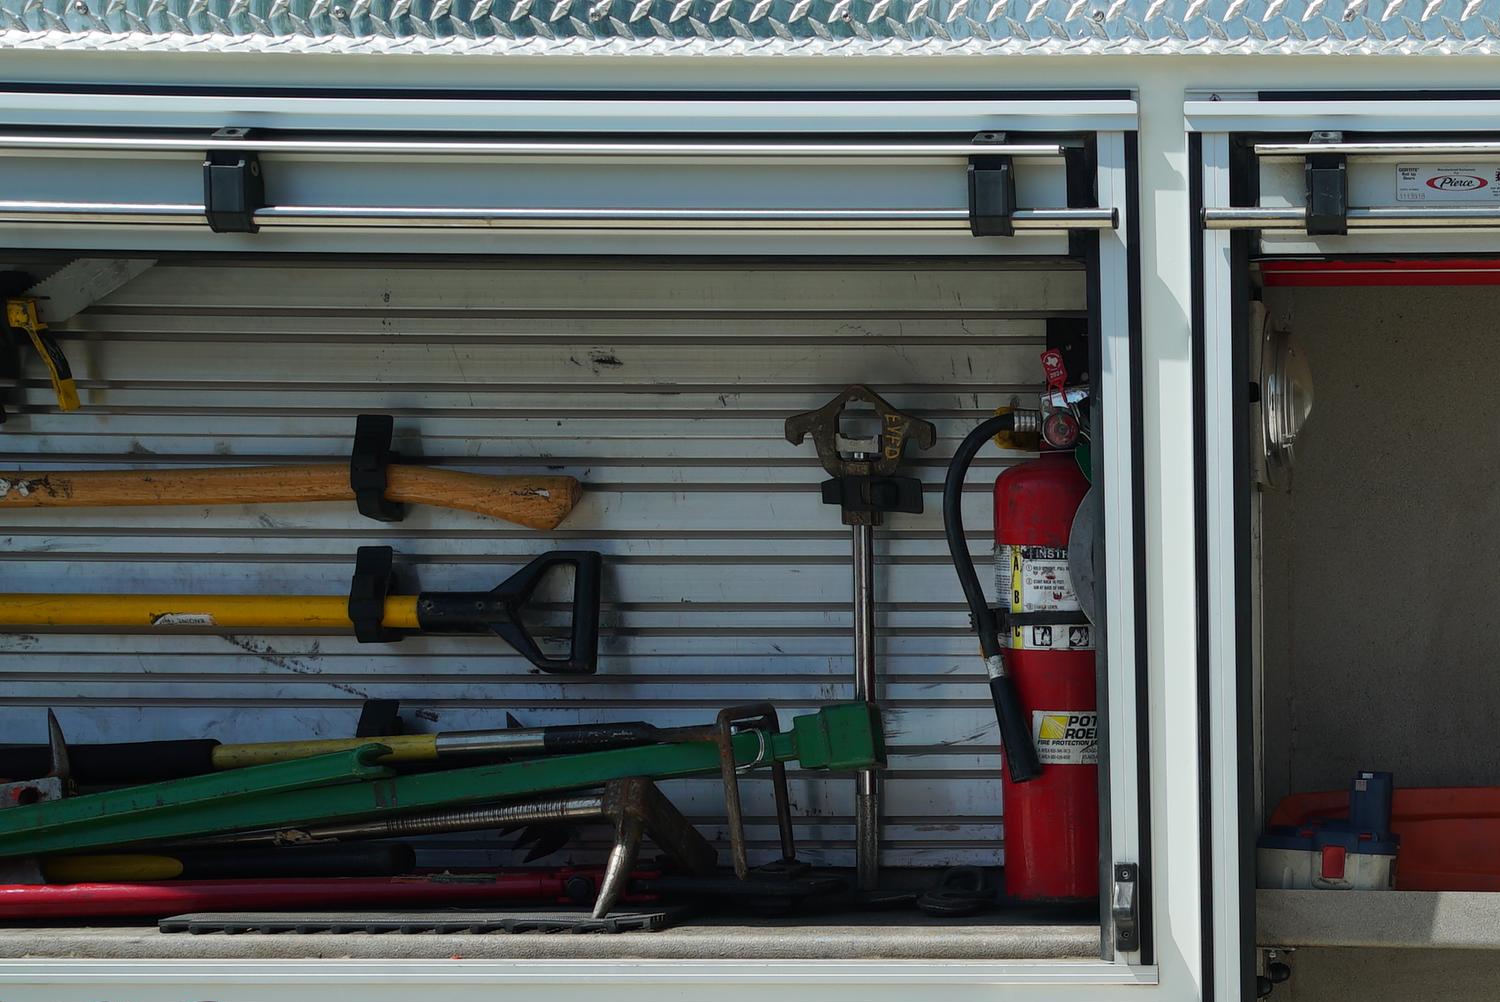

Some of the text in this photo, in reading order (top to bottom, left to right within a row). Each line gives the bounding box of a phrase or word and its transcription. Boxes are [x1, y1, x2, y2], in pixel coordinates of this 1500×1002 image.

[1440, 177, 1474, 191] Pierce
[1013, 556, 1019, 571] A
[1014, 590, 1020, 604] B
